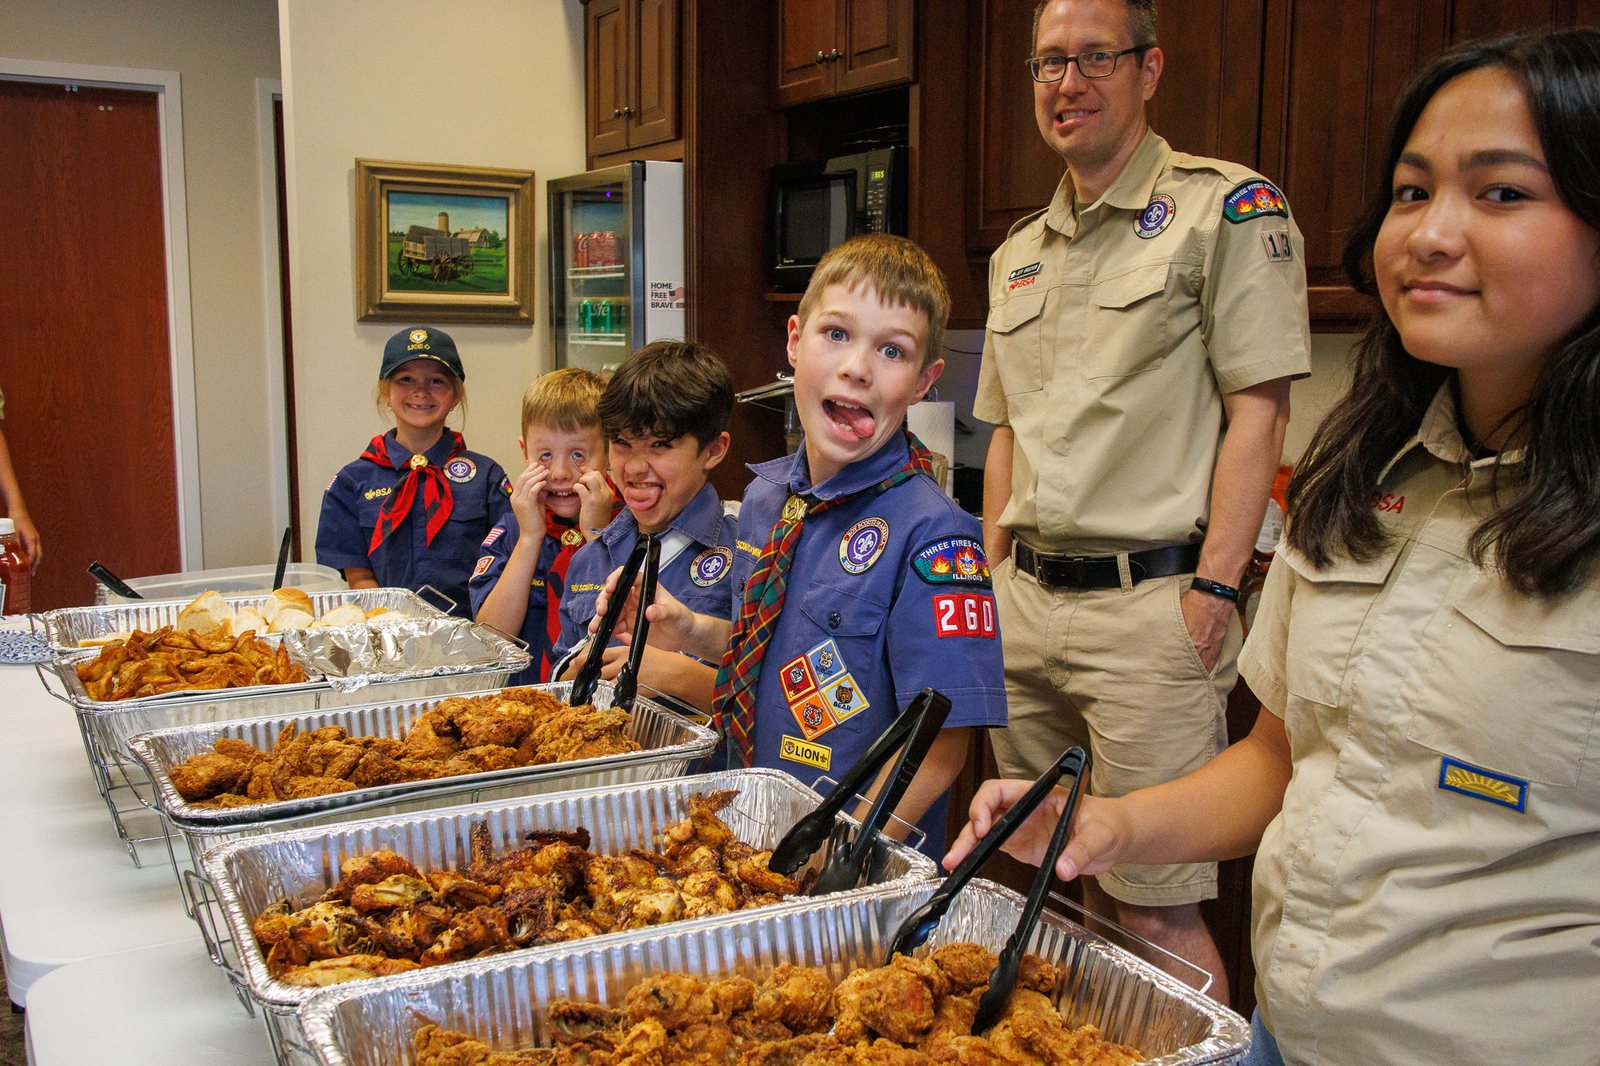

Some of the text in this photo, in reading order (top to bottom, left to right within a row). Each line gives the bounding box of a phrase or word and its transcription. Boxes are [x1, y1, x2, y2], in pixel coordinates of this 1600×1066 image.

[1229, 187, 1248, 204] THREE
[1017, 276, 1035, 288] BSA
[375, 487, 392, 498] BSA
[920, 541, 950, 559] THREE
[951, 539, 972, 547] FIRES
[952, 573, 983, 582] ILLINOIS
[939, 599, 993, 632] 260
[833, 701, 852, 711] BEAR
[795, 745, 820, 762] LION
